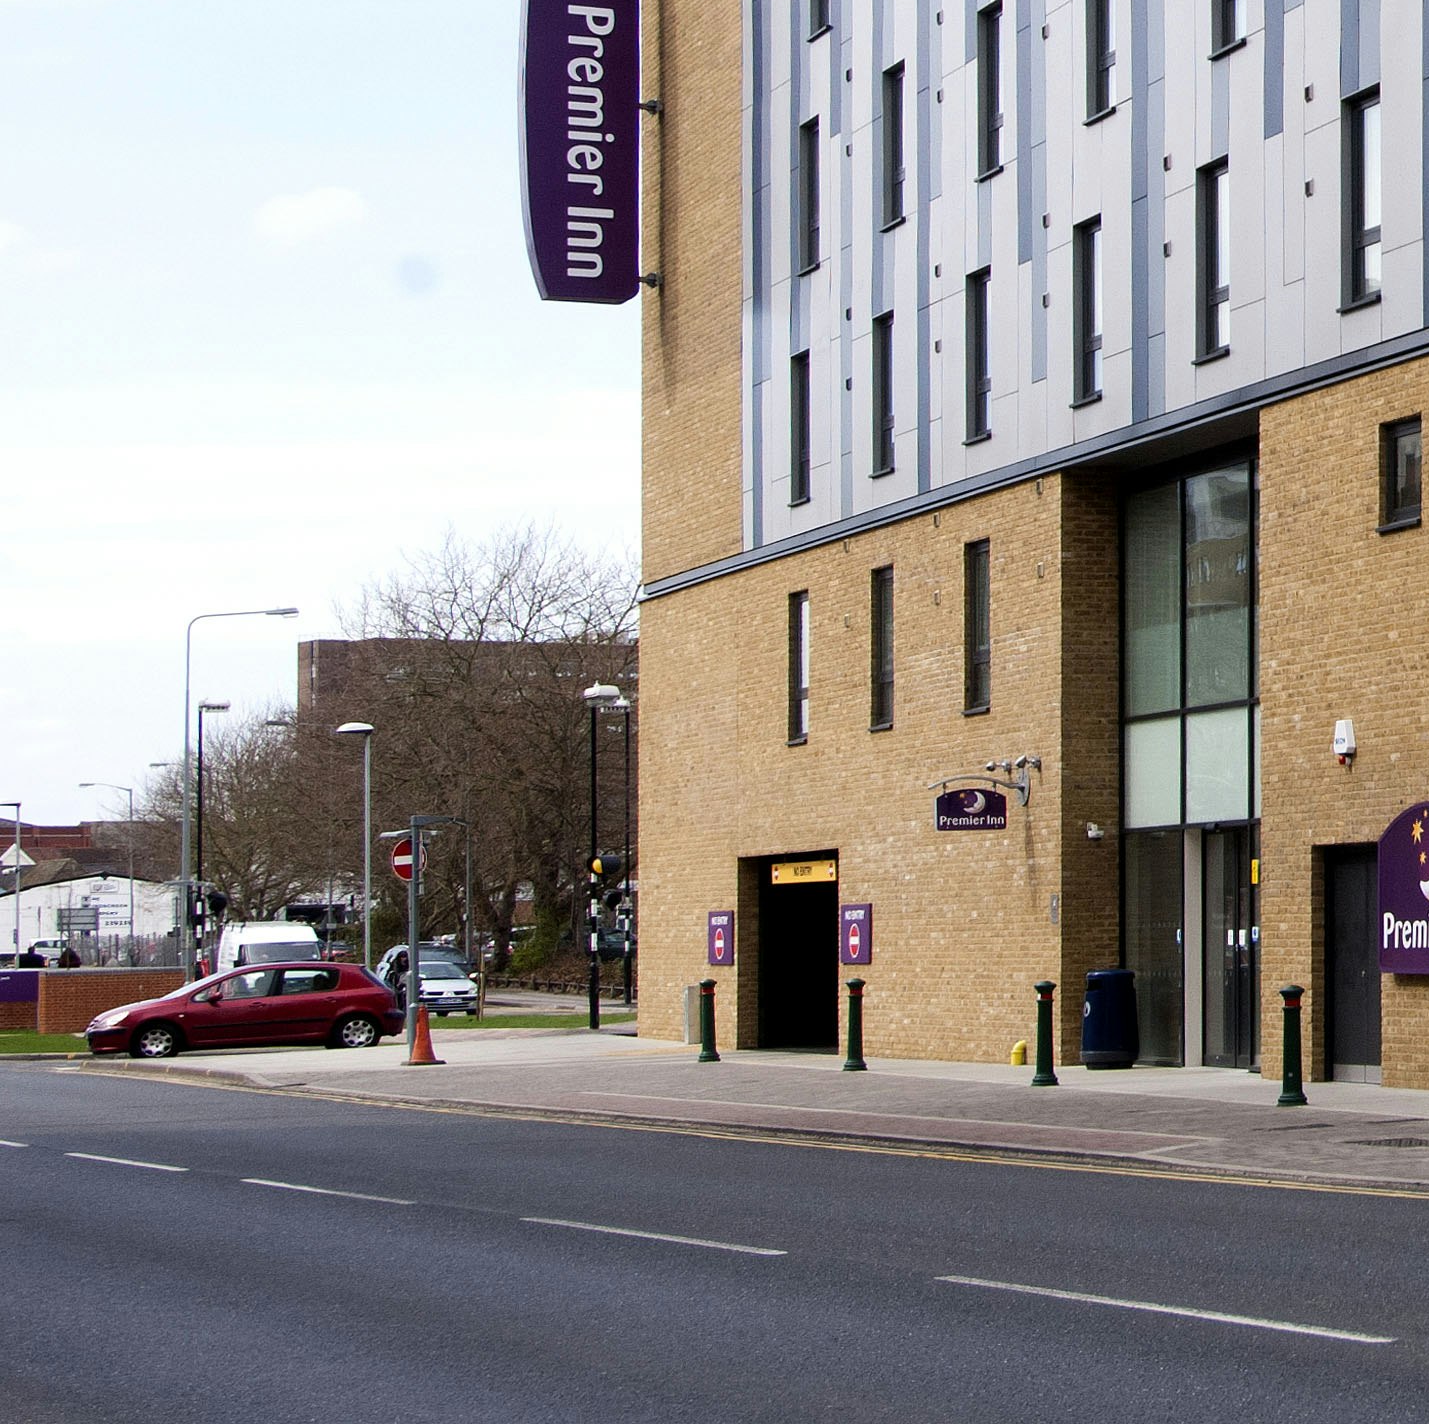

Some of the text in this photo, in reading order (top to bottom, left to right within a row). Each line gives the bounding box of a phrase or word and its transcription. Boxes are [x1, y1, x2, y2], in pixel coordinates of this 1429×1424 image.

[567, 4, 615, 278] Premier Inn
[940, 815, 1005, 826] Premier Inn
